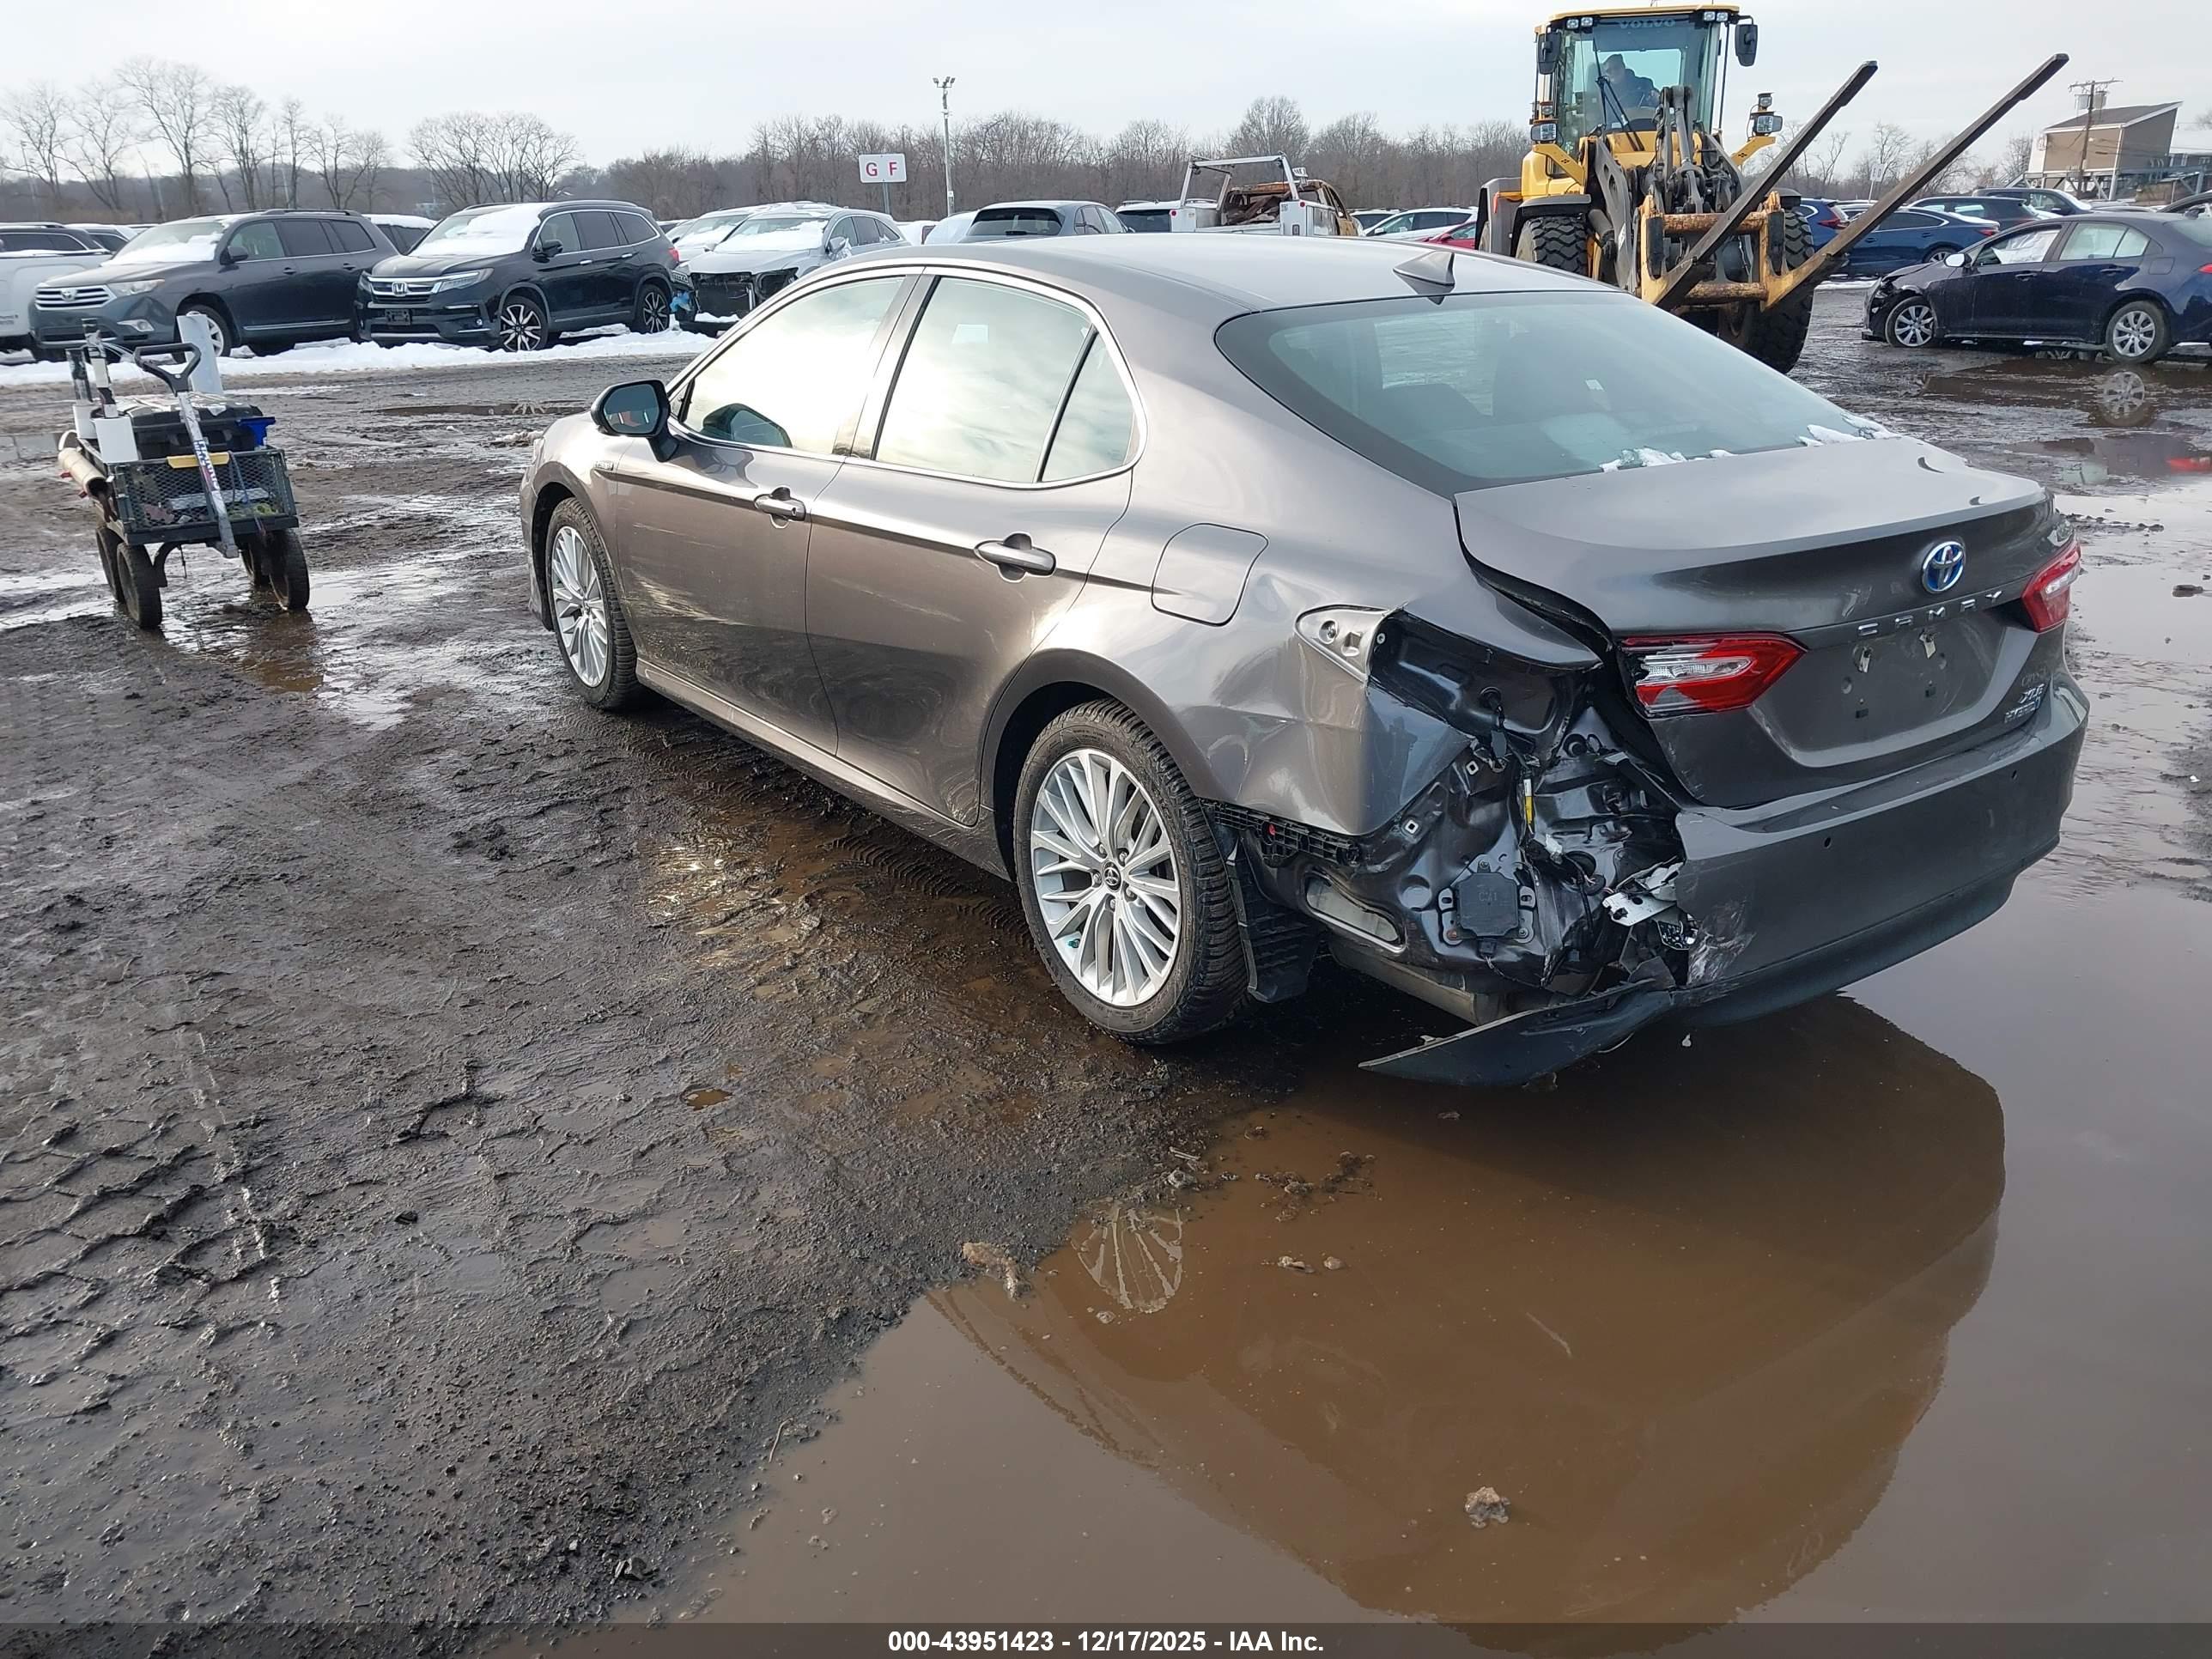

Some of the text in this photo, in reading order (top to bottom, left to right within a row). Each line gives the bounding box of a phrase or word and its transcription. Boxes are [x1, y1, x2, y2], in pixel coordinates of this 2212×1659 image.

[1620, 19, 1676, 28] VOLVO
[866, 161, 898, 177] G F
[1858, 591, 2002, 636] CAMRY
